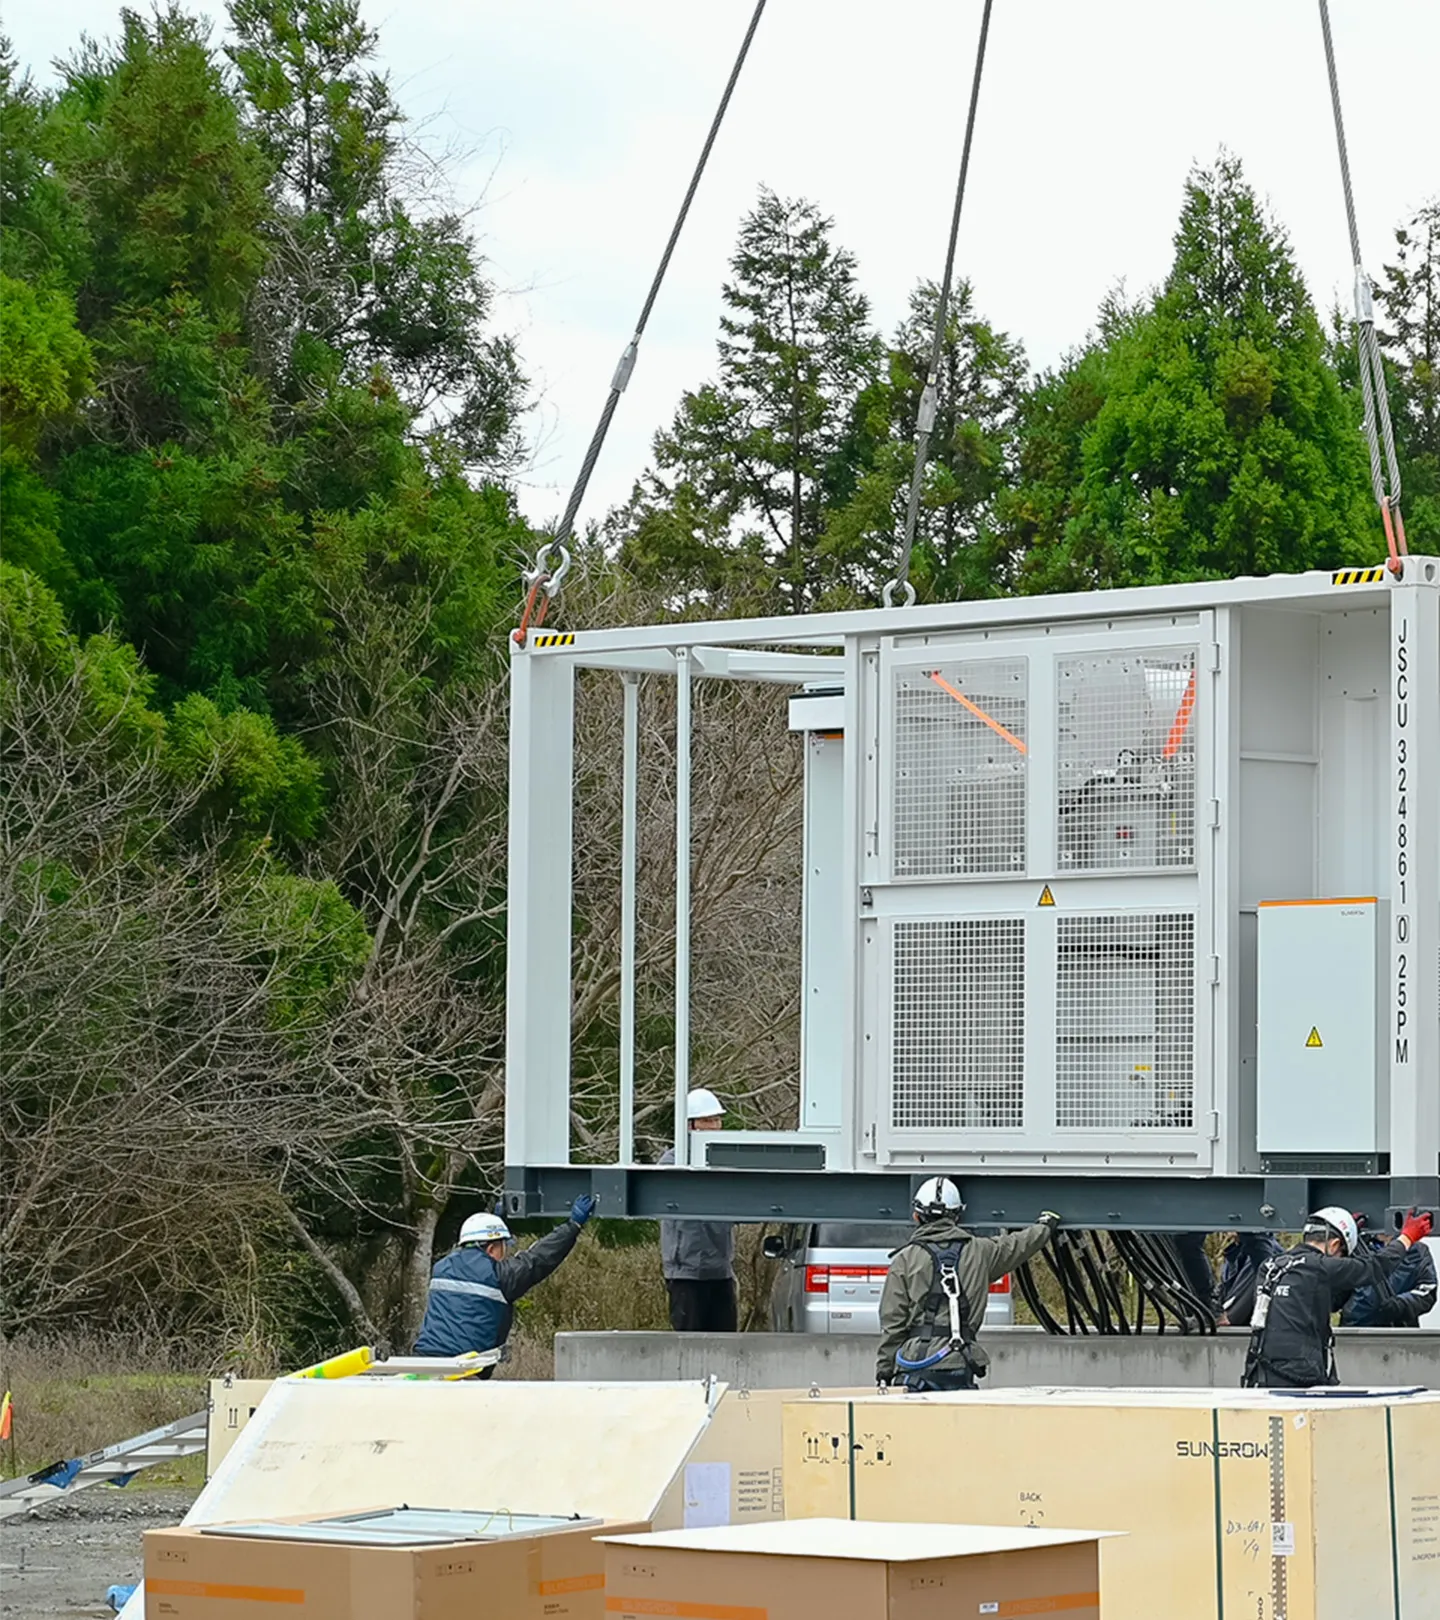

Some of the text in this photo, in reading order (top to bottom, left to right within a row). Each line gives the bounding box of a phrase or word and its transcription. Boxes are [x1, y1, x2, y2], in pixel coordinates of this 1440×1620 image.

[1397, 618, 1408, 728] JSCU
[1397, 739, 1407, 904] 324861
[1396, 954, 1408, 1063] 25PM
[1019, 1491, 1042, 1502] BACK
[1176, 1441, 1269, 1459] SUNGROW
